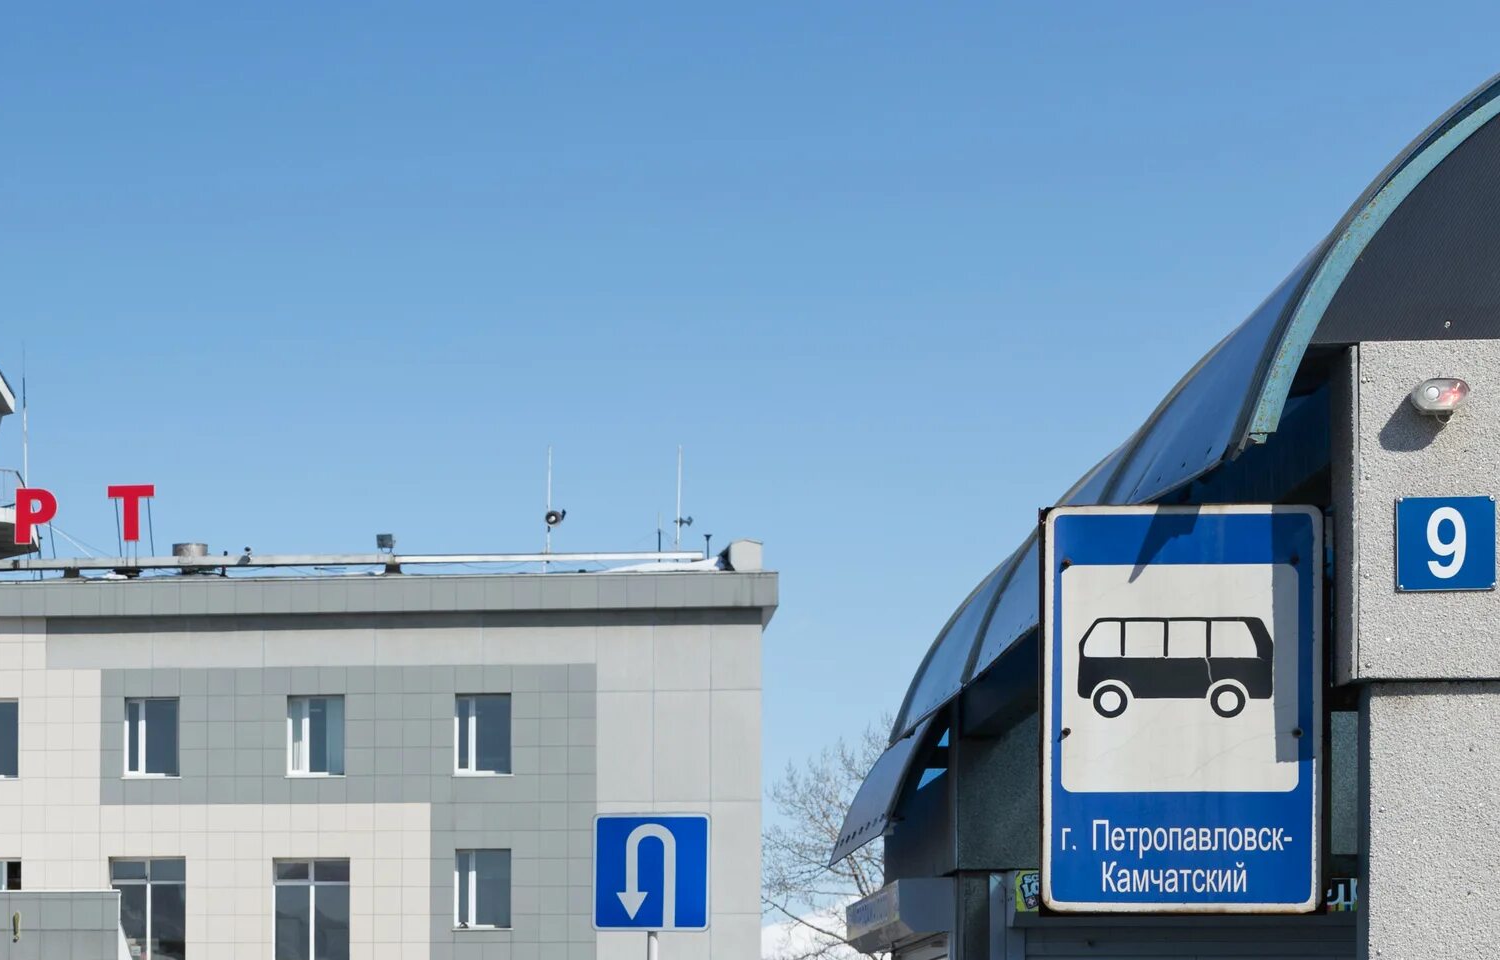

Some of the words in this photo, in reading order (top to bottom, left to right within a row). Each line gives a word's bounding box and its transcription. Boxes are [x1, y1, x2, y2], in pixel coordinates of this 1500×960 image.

[1427, 506, 1467, 579] 9
[1061, 827, 1077, 851] г.
[1092, 819, 1293, 859] Петропавловск-
[1101, 861, 1248, 893] Камчатский
